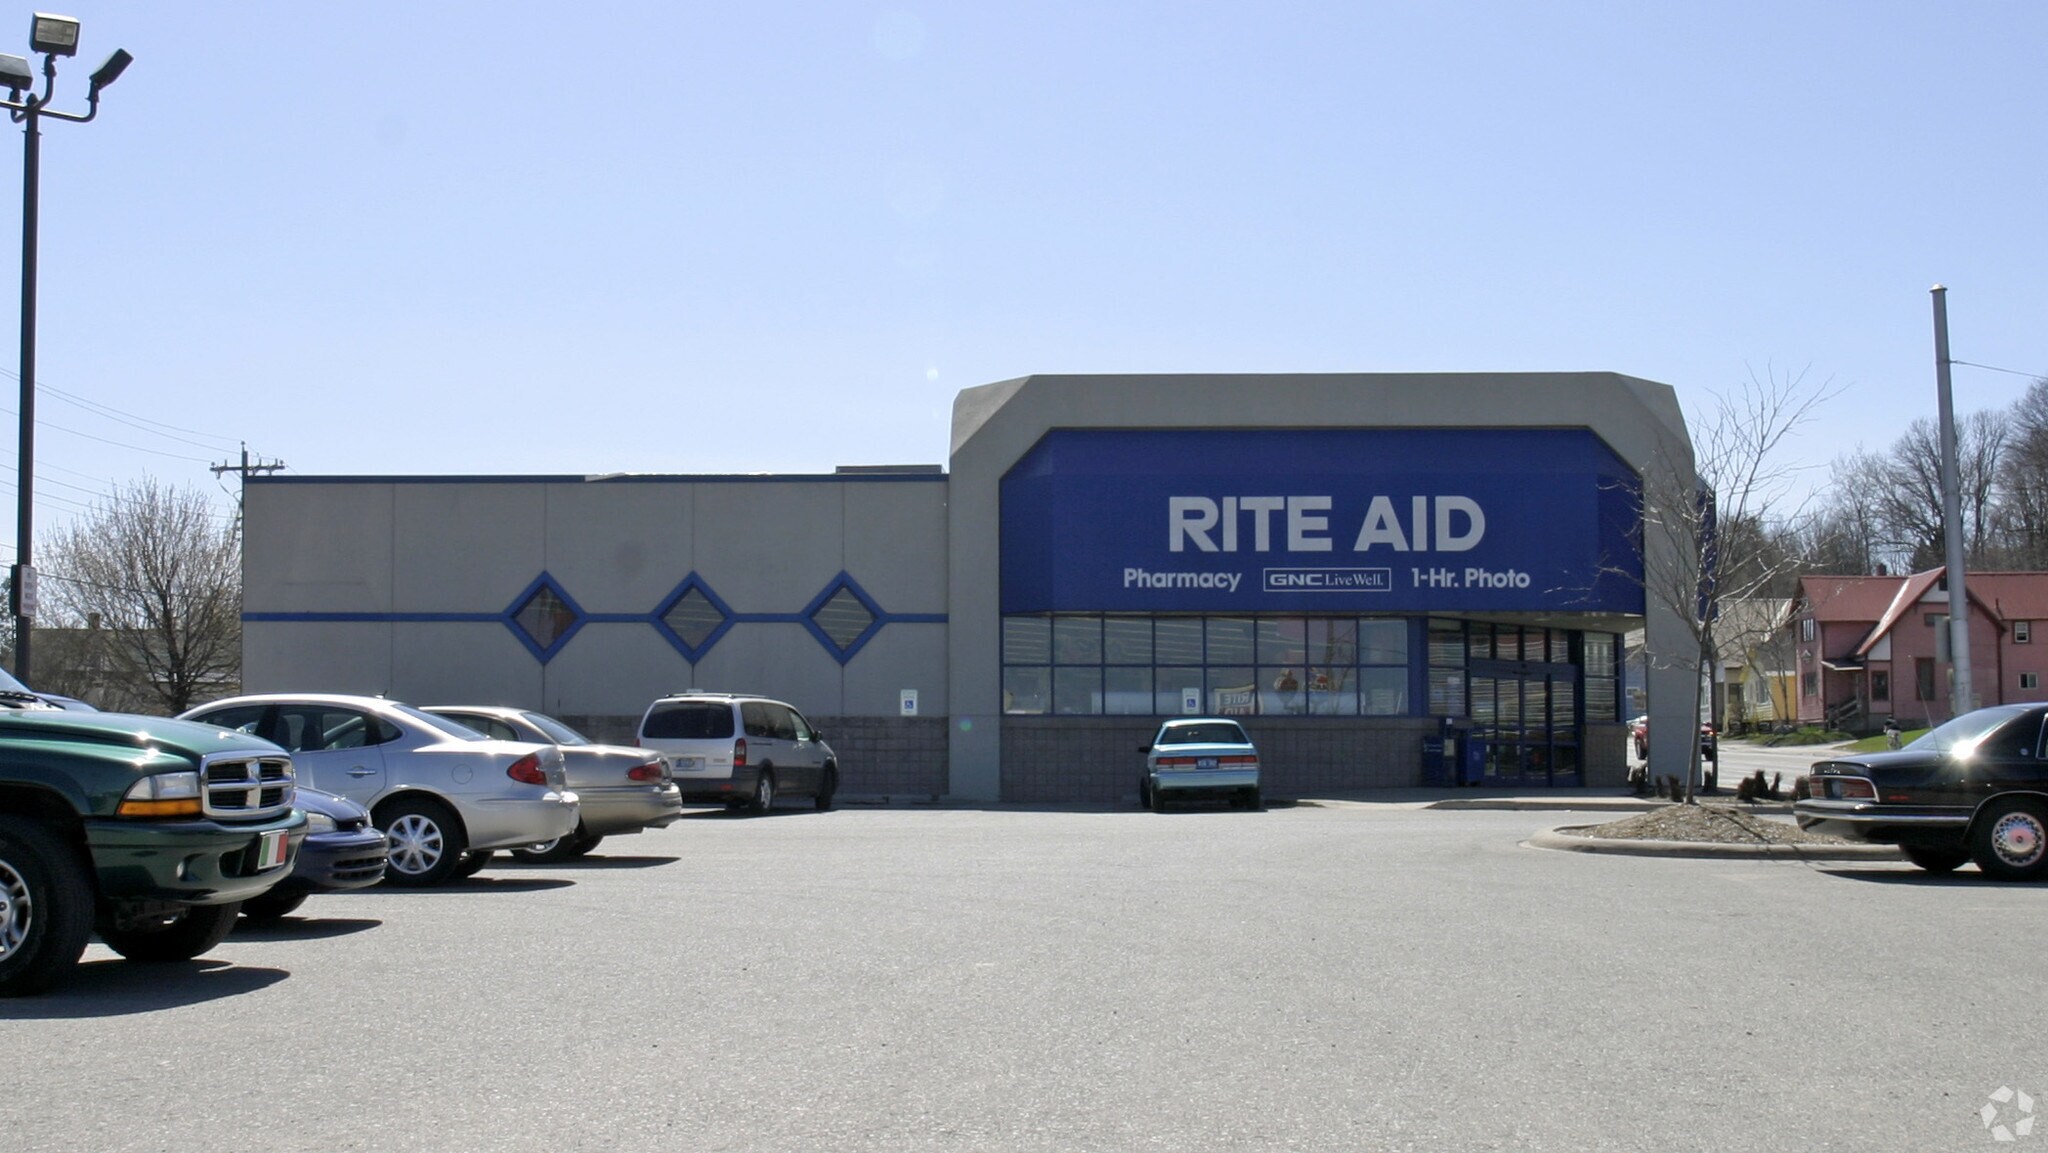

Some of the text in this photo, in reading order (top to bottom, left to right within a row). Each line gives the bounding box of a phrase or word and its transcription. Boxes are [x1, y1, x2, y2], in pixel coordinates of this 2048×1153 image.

[1169, 496, 1486, 552] RITE AID
[1124, 568, 1242, 592] Pharmacy
[1270, 573, 1323, 586] GNC
[1411, 567, 1530, 588] 1-Hr. Photo
